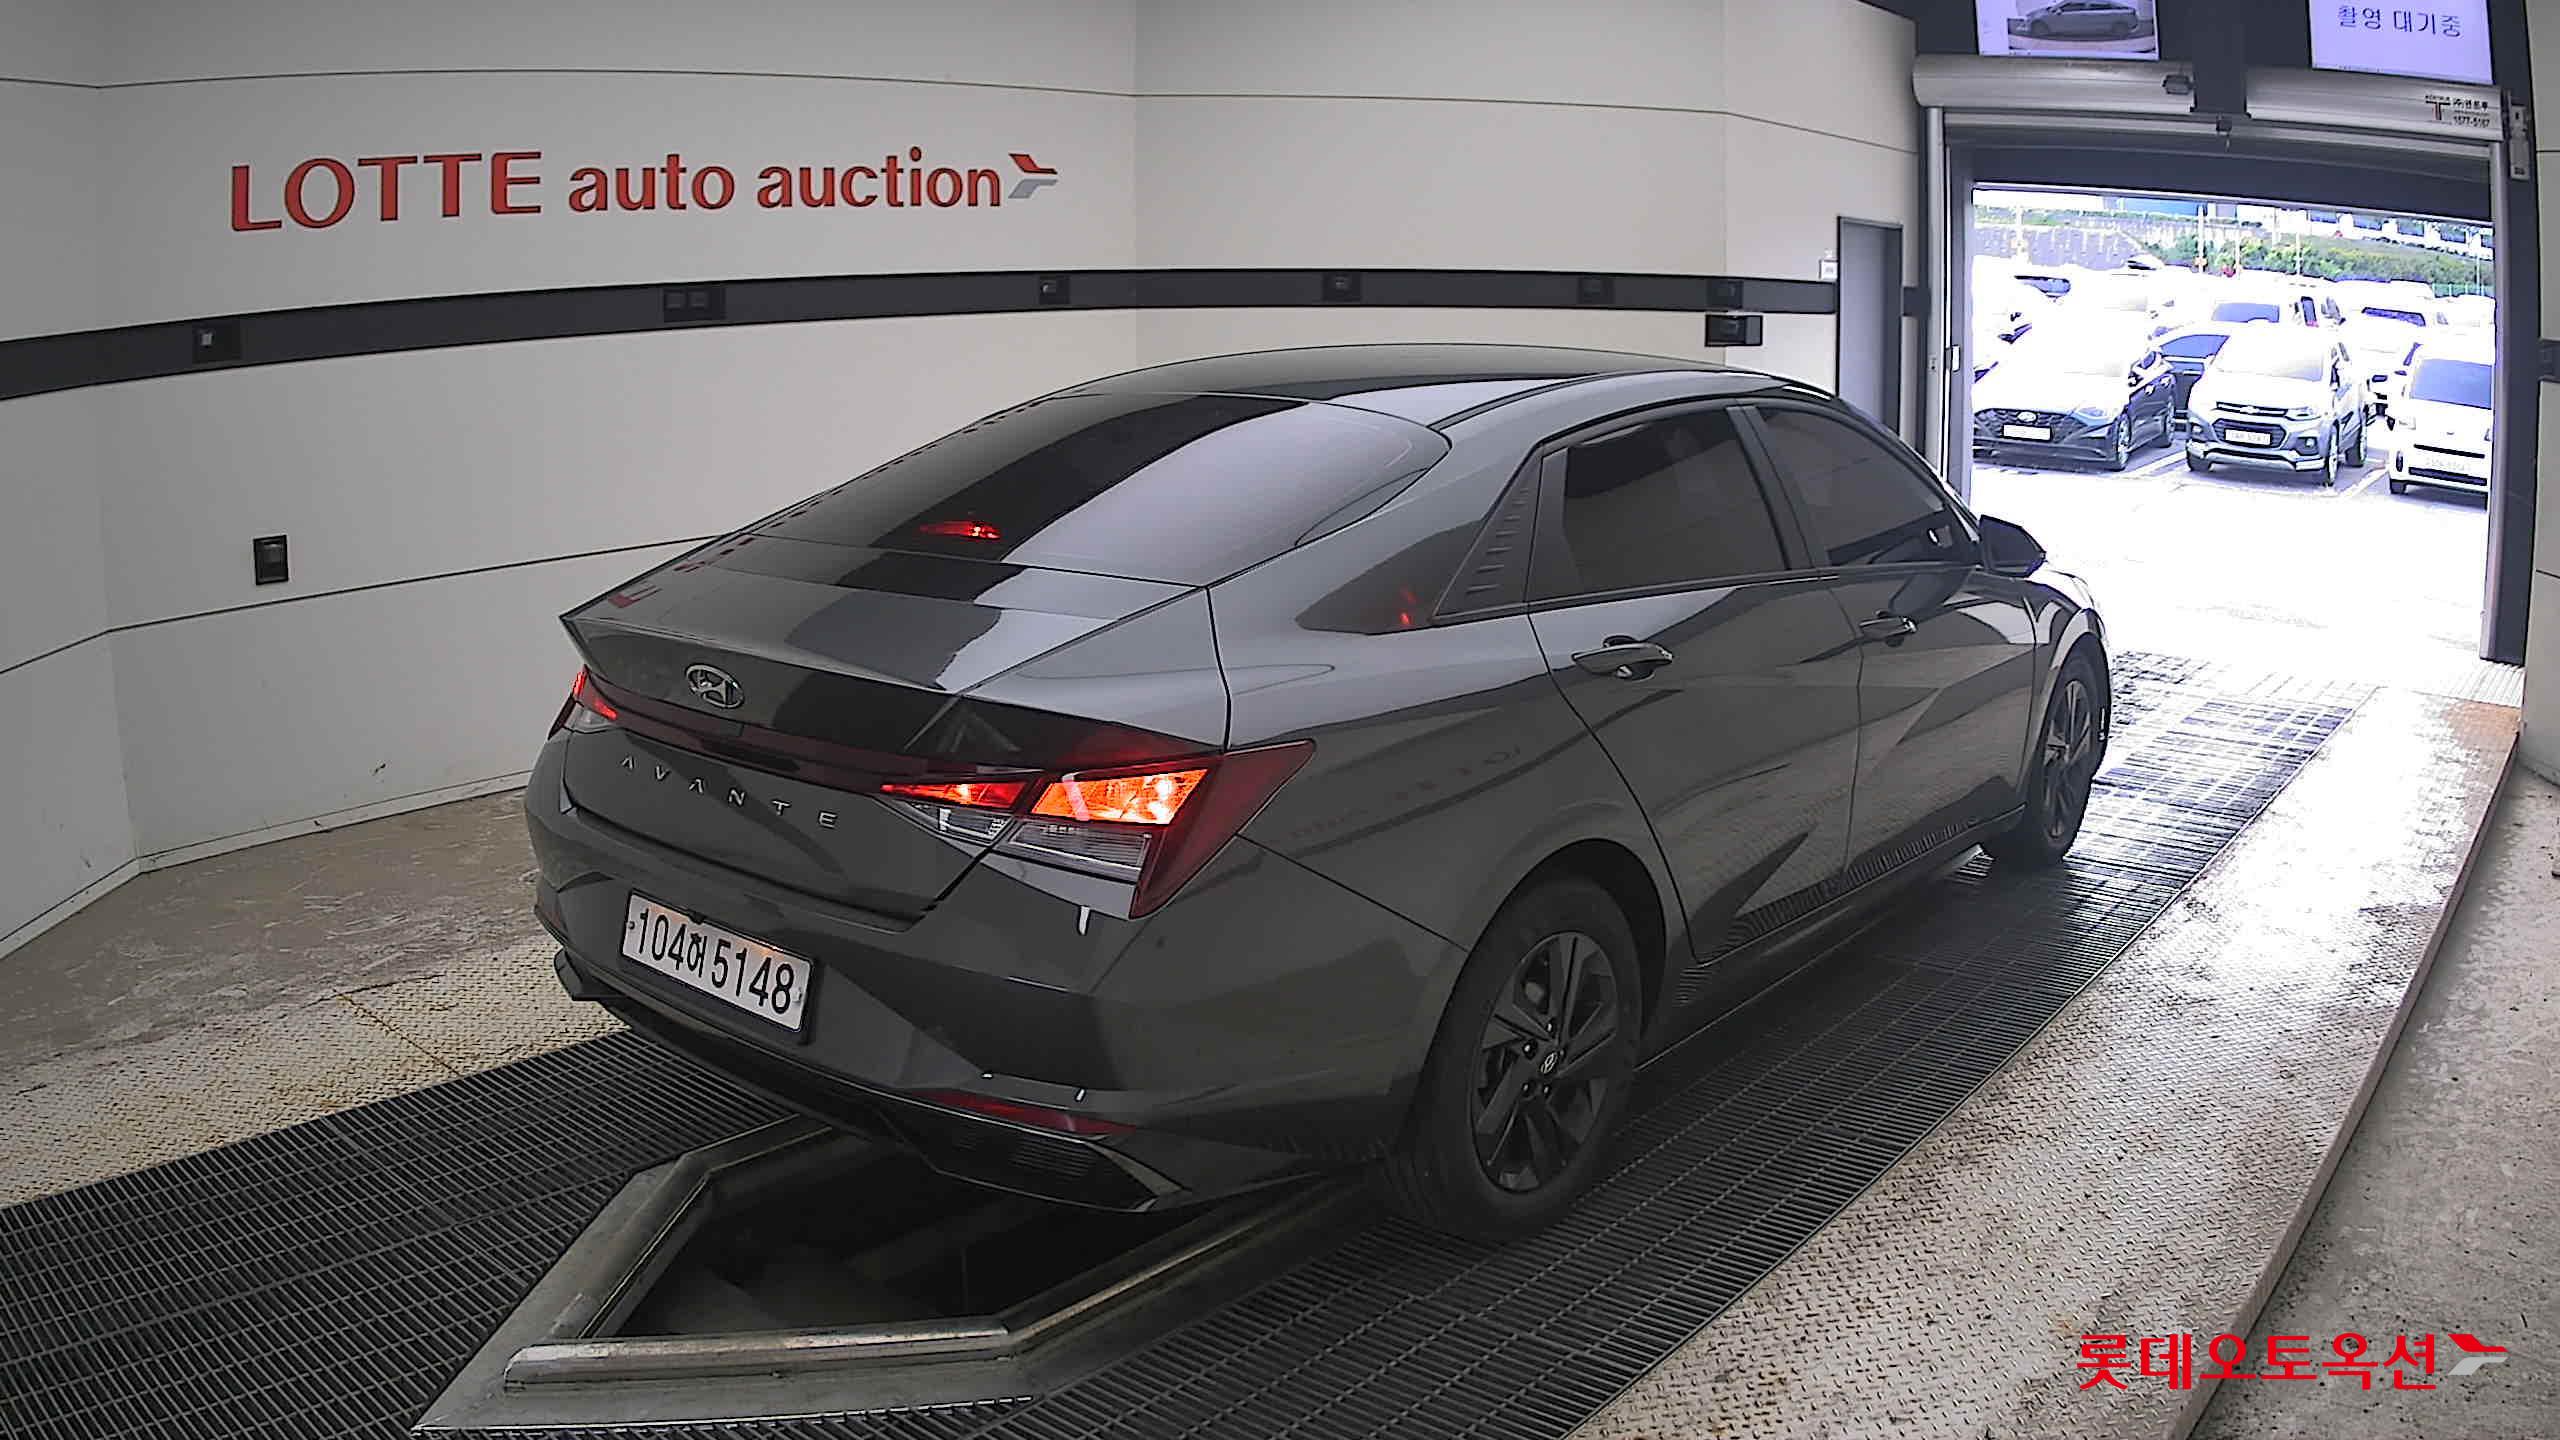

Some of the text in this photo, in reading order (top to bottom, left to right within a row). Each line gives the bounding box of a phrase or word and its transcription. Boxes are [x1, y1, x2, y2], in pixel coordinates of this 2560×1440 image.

[2338, 5, 2461, 38] 촬영 대기중
[231, 147, 1002, 232] LOTTE auto auction
[620, 755, 838, 830] AVANTE
[711, 938, 794, 1015] 5148
